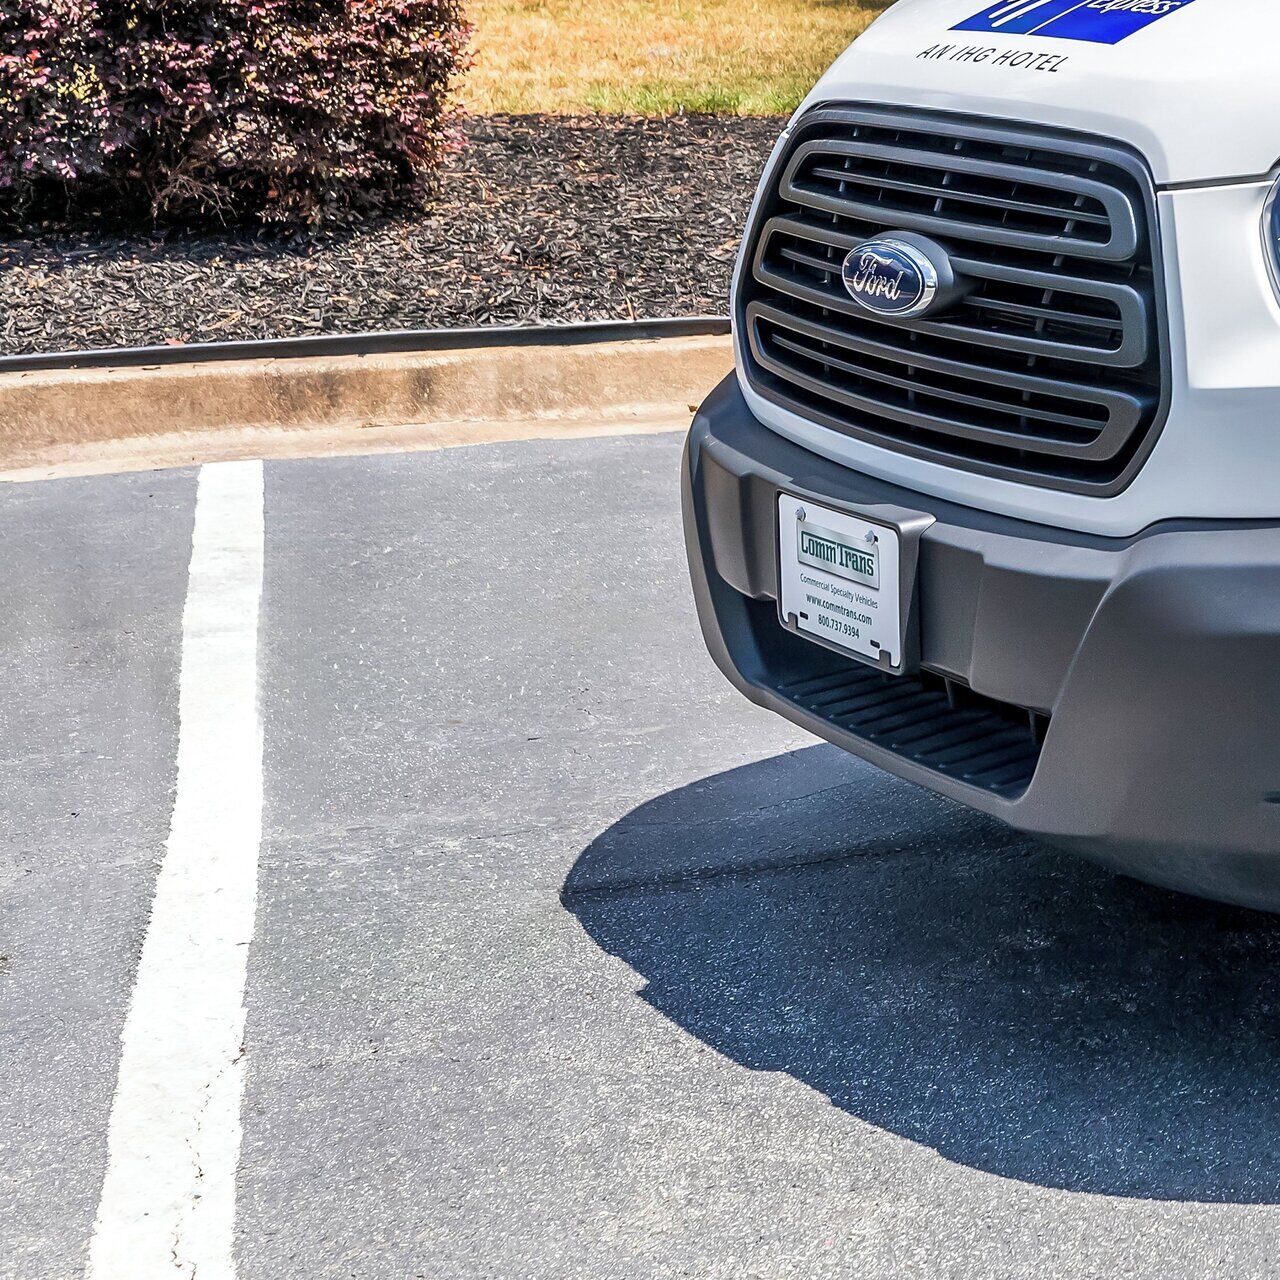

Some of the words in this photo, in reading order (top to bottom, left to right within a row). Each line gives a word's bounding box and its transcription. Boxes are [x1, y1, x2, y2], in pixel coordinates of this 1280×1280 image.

[916, 44, 956, 59] AN
[949, 45, 997, 63] IHG
[992, 50, 1068, 73] HOTEL
[853, 252, 904, 301] Ford
[800, 573, 830, 592] Commercial
[830, 584, 854, 602] Specialty
[854, 592, 878, 609] Vehicles
[806, 593, 873, 625] www.commtrans.com
[818, 613, 860, 638] 800.737.9394
